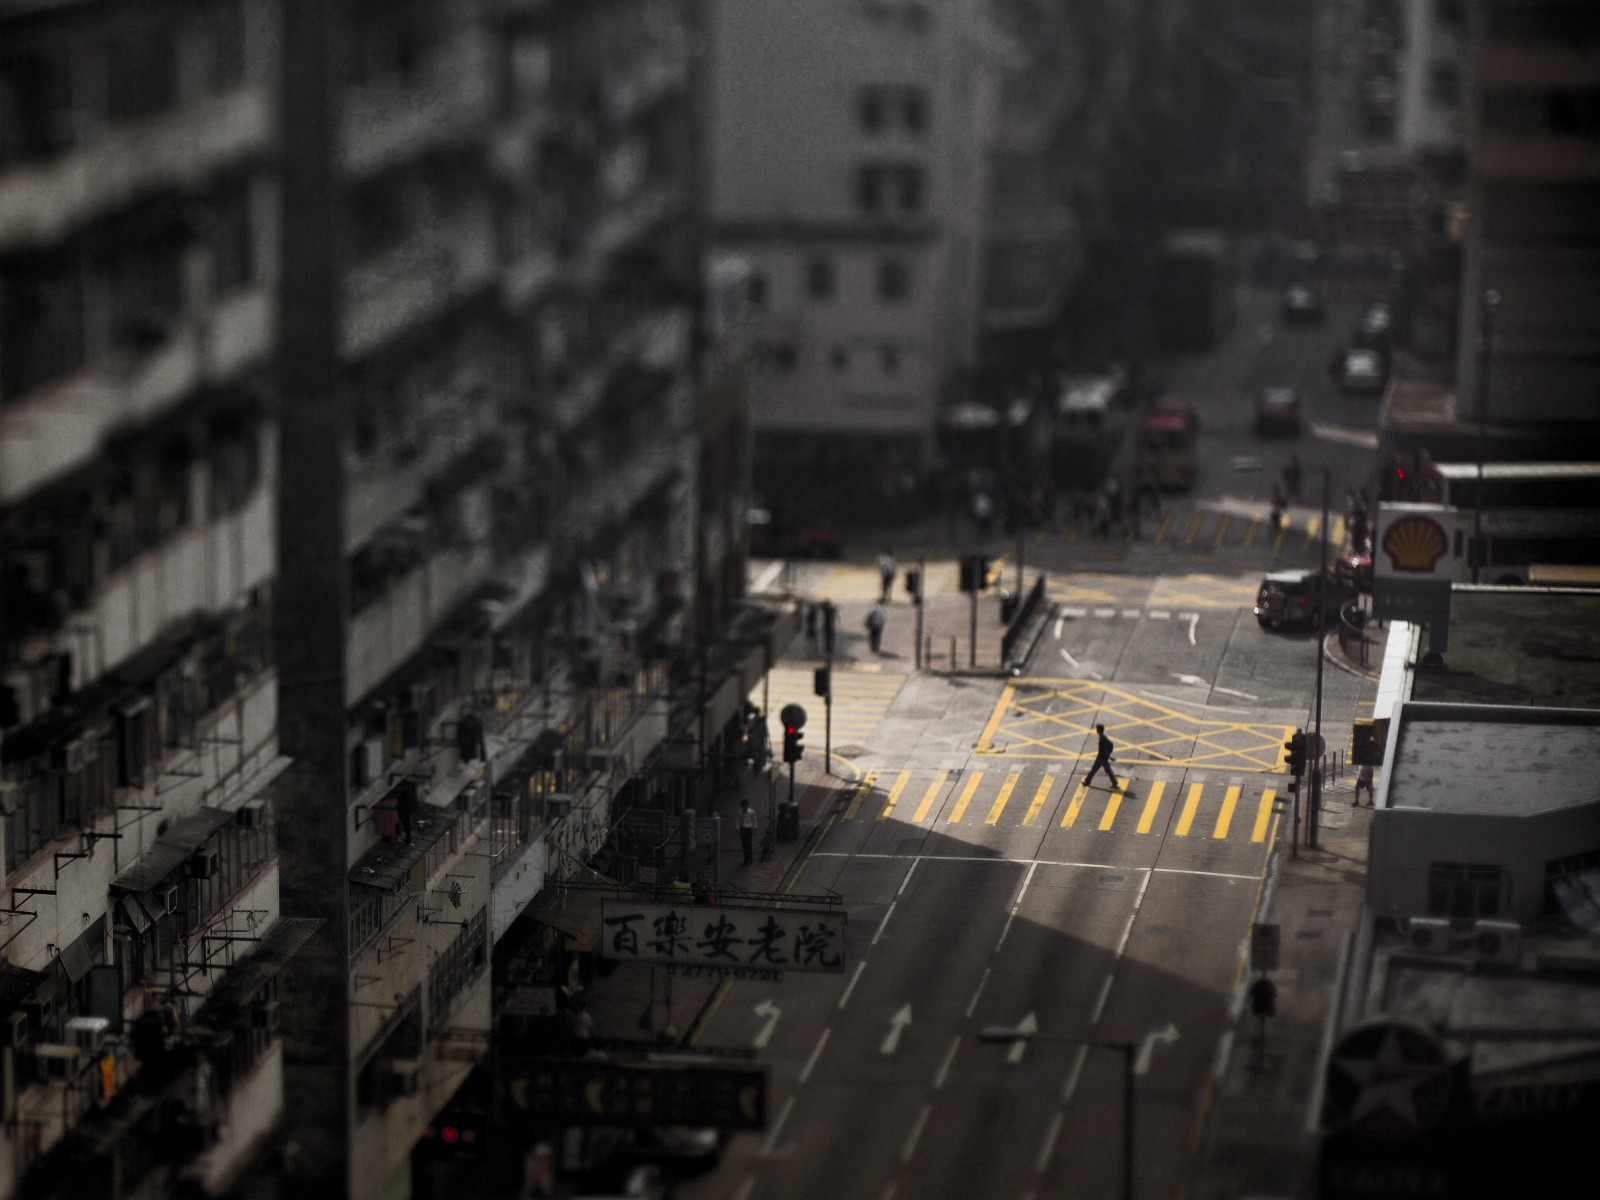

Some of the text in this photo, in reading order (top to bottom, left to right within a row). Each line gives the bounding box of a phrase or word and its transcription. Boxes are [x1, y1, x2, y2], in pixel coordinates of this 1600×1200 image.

[604, 910, 841, 967] 百樂安老院
